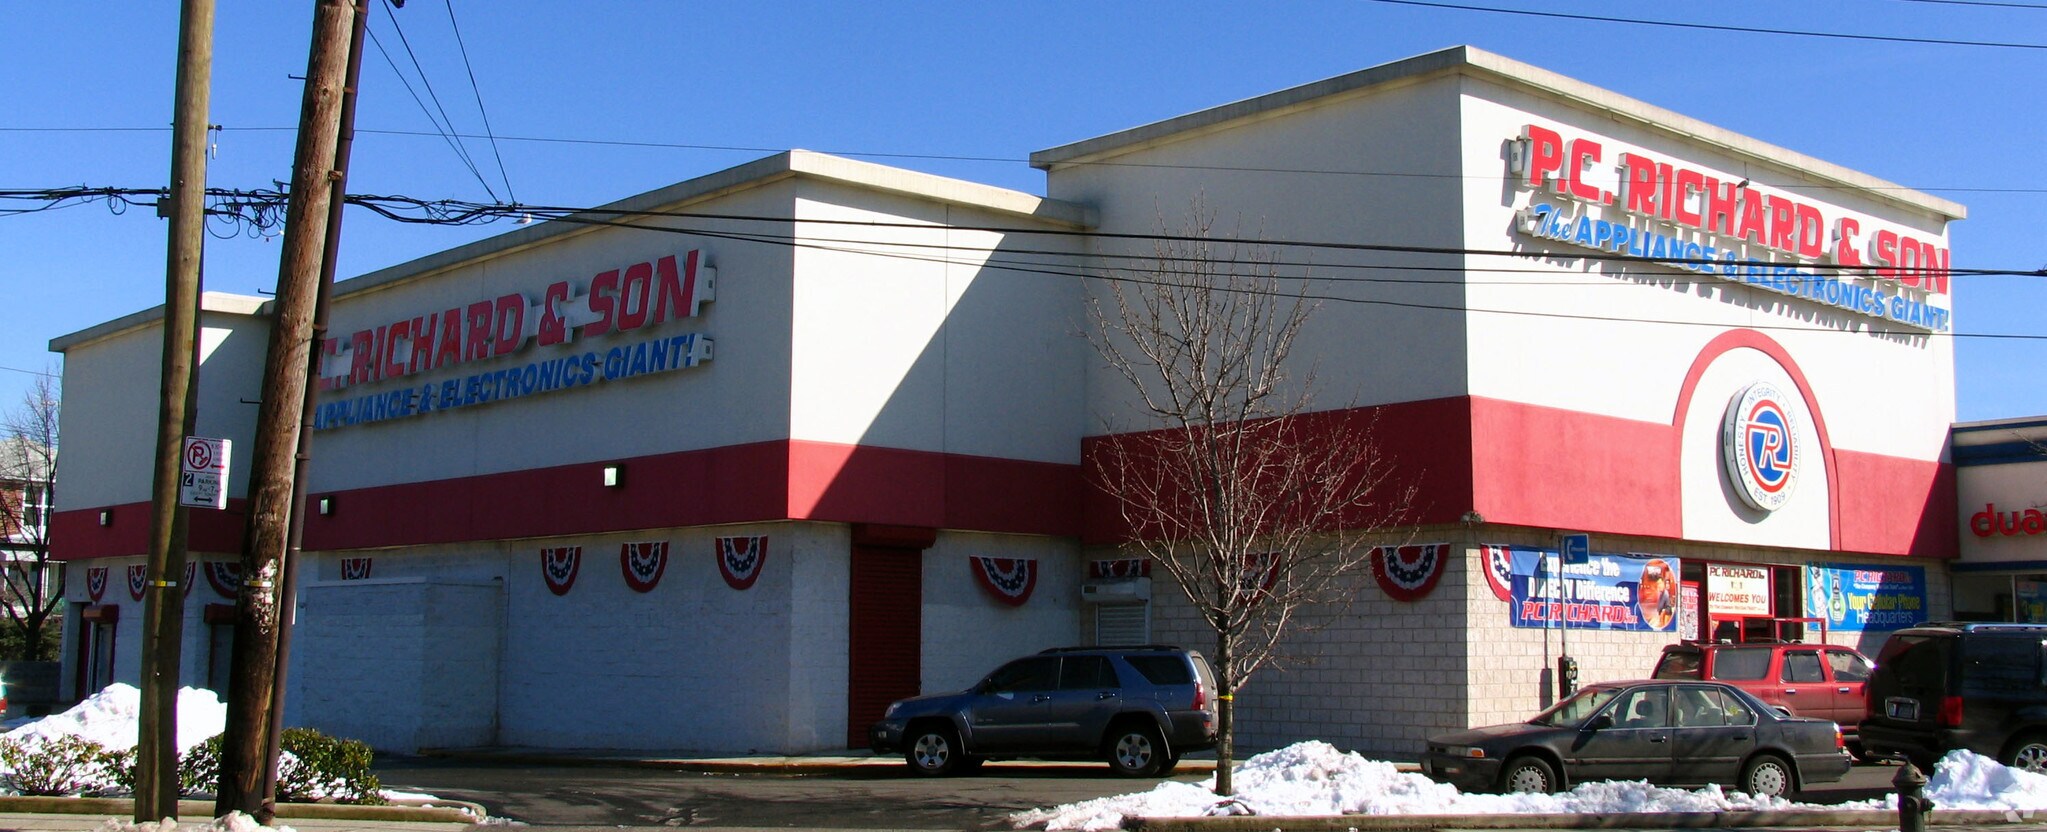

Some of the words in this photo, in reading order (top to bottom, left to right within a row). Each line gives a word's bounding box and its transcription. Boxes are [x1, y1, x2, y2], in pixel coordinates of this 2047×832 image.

[1528, 124, 1613, 206] P.C.
[1626, 152, 1824, 260] RICHARD
[1837, 217, 1862, 270] &
[1876, 229, 1949, 295] SON
[1533, 203, 1572, 240] The
[1574, 215, 1716, 274] APPLIANCE
[1723, 250, 1739, 281] &
[1746, 257, 1886, 317] ELECTRONICS
[1891, 295, 1949, 332] GIANT!
[349, 293, 528, 386] RICHARD
[537, 280, 569, 348] &
[584, 249, 699, 339] SON
[419, 382, 437, 412] &
[439, 351, 597, 410] ELECTRONICS
[604, 332, 697, 382] GIANT!
[1970, 503, 2047, 538] dua
[1601, 557, 1620, 577] the
[1576, 579, 1630, 602] Difference
[1708, 591, 1749, 604] WELCOMES
[1751, 594, 1767, 604] YOU
[1847, 592, 1867, 610] Your
